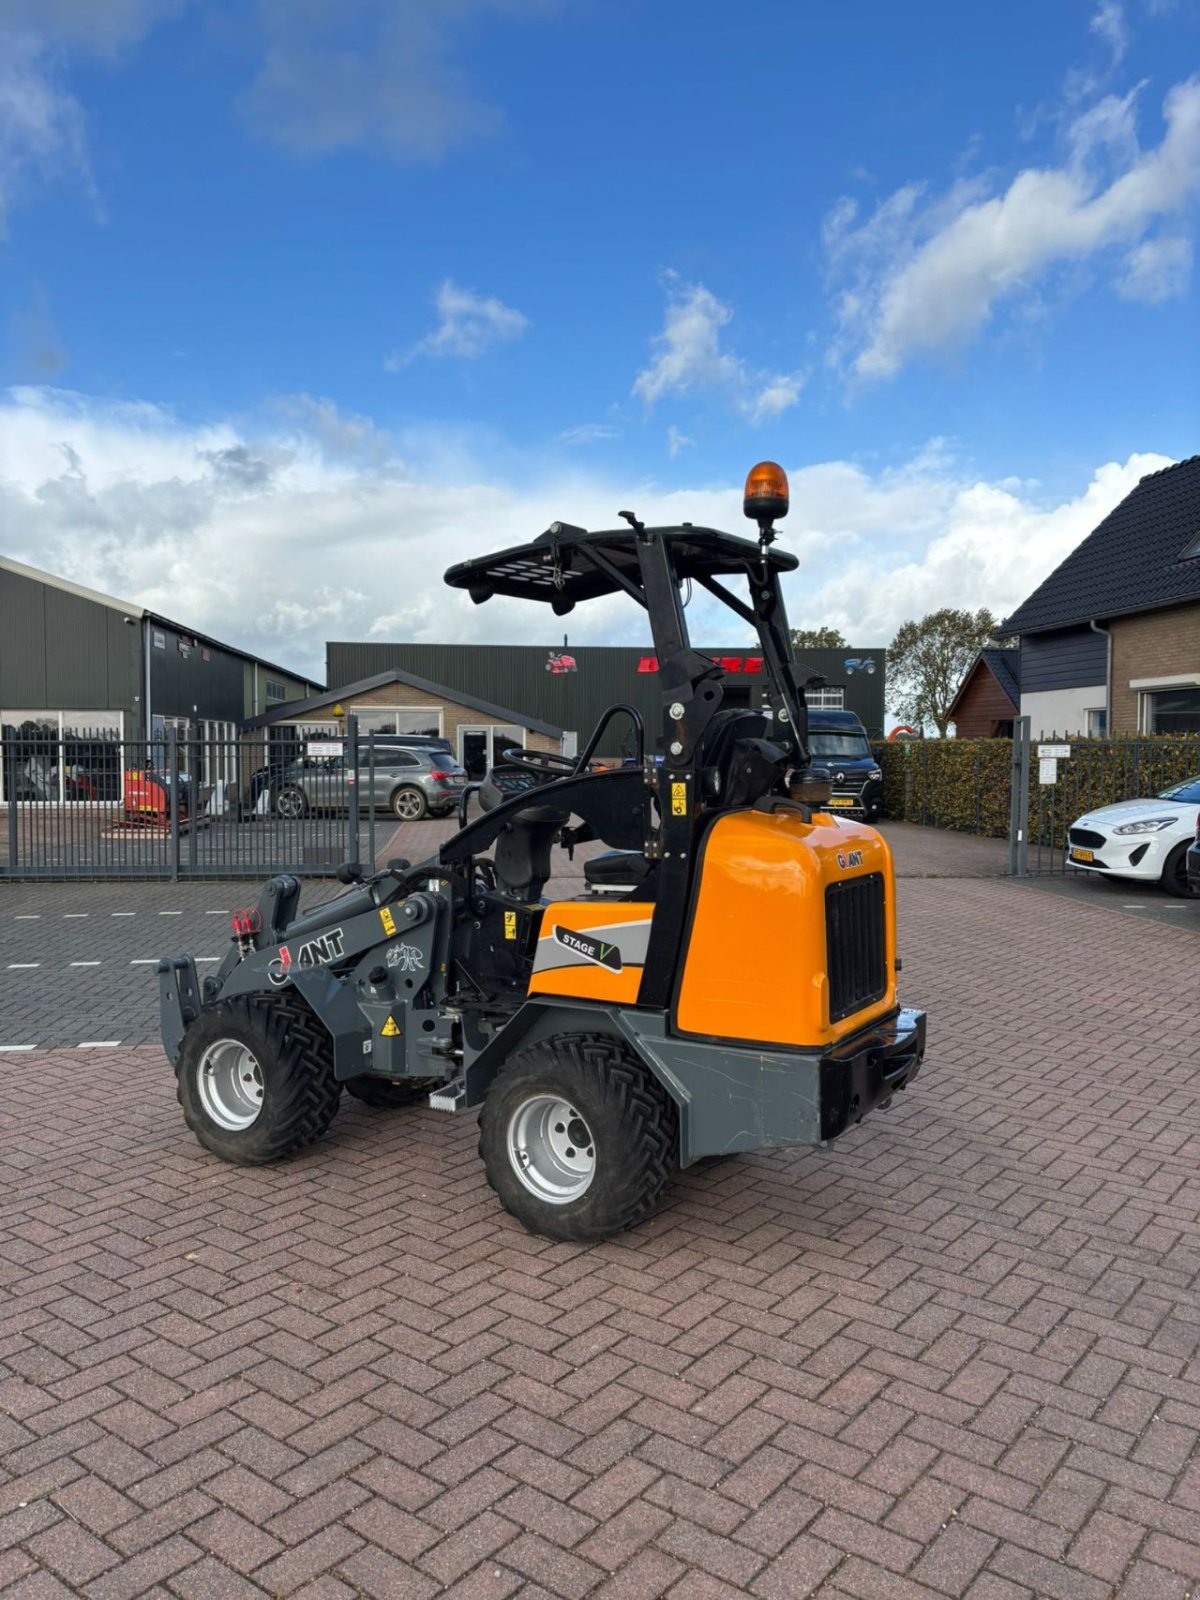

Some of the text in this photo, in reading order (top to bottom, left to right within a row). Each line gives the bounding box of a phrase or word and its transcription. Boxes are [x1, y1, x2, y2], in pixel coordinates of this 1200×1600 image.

[836, 848, 864, 870] GIANT
[562, 934, 617, 960] STAGE V
